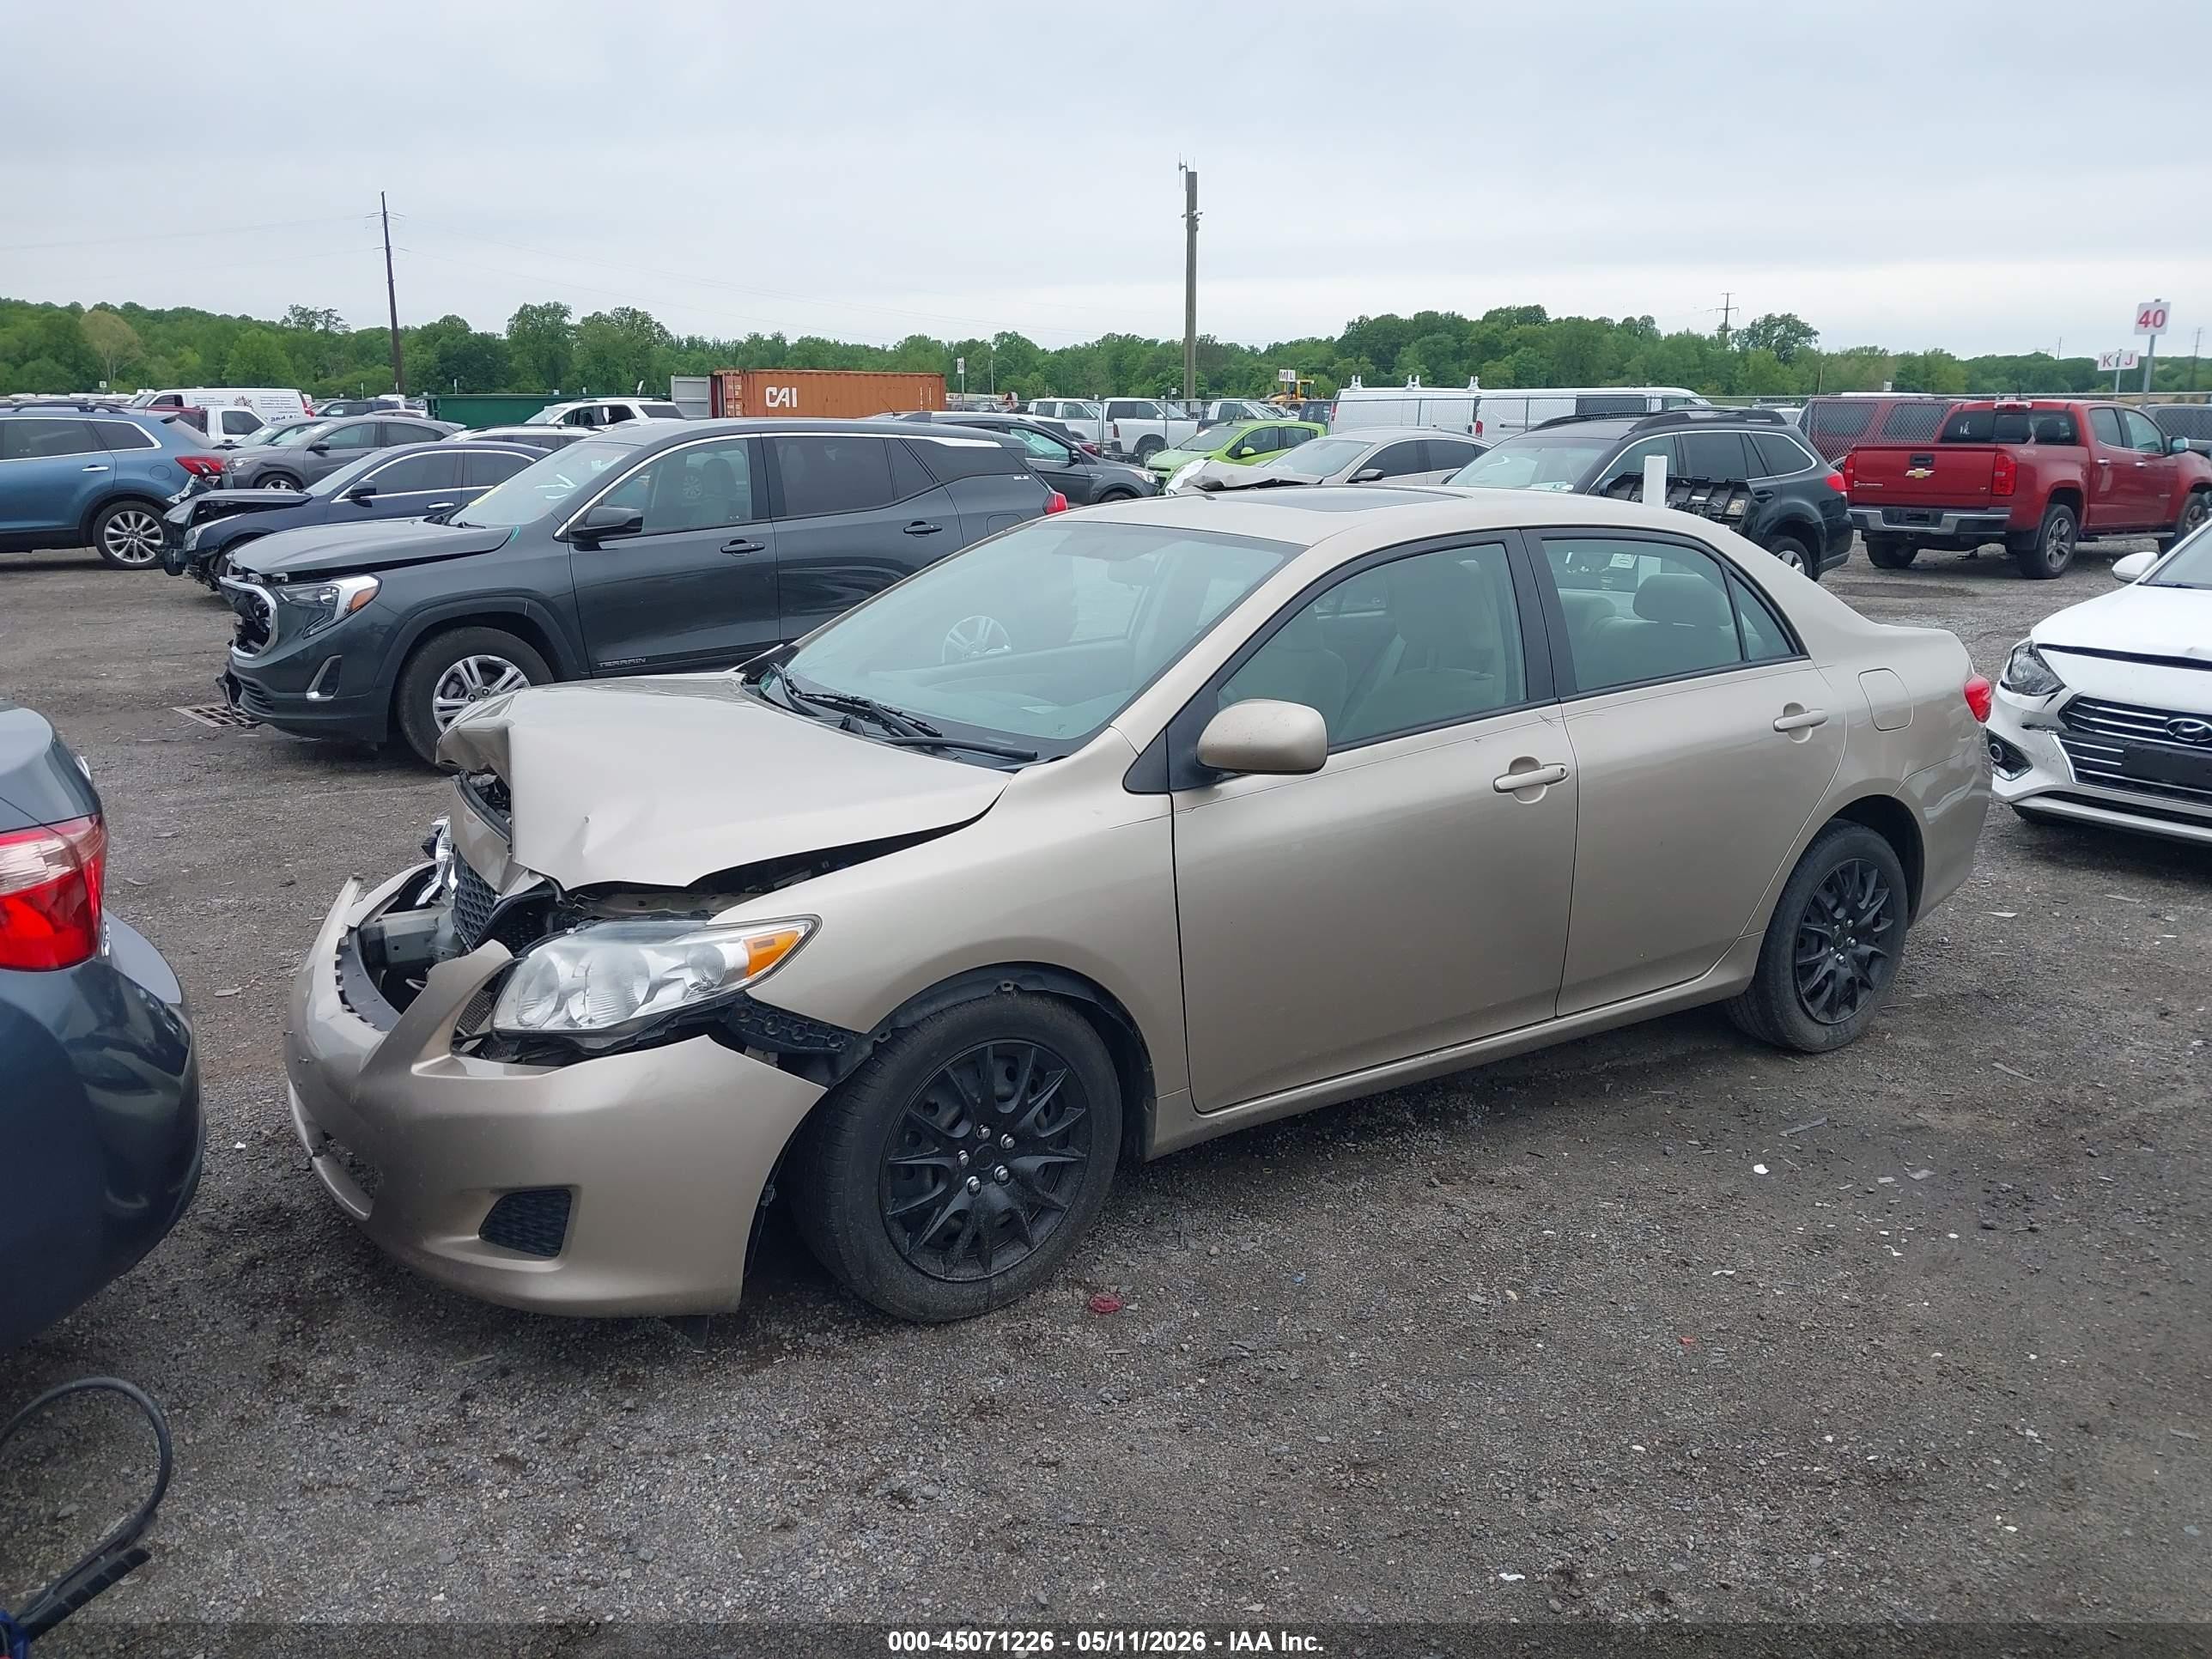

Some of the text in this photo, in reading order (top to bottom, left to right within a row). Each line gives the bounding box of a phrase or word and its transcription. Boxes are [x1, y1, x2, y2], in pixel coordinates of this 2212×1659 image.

[2137, 309, 2166, 328] 40
[2102, 353, 2134, 368] K J
[765, 386, 798, 408] CAI
[597, 658, 647, 667] TERRAIN
